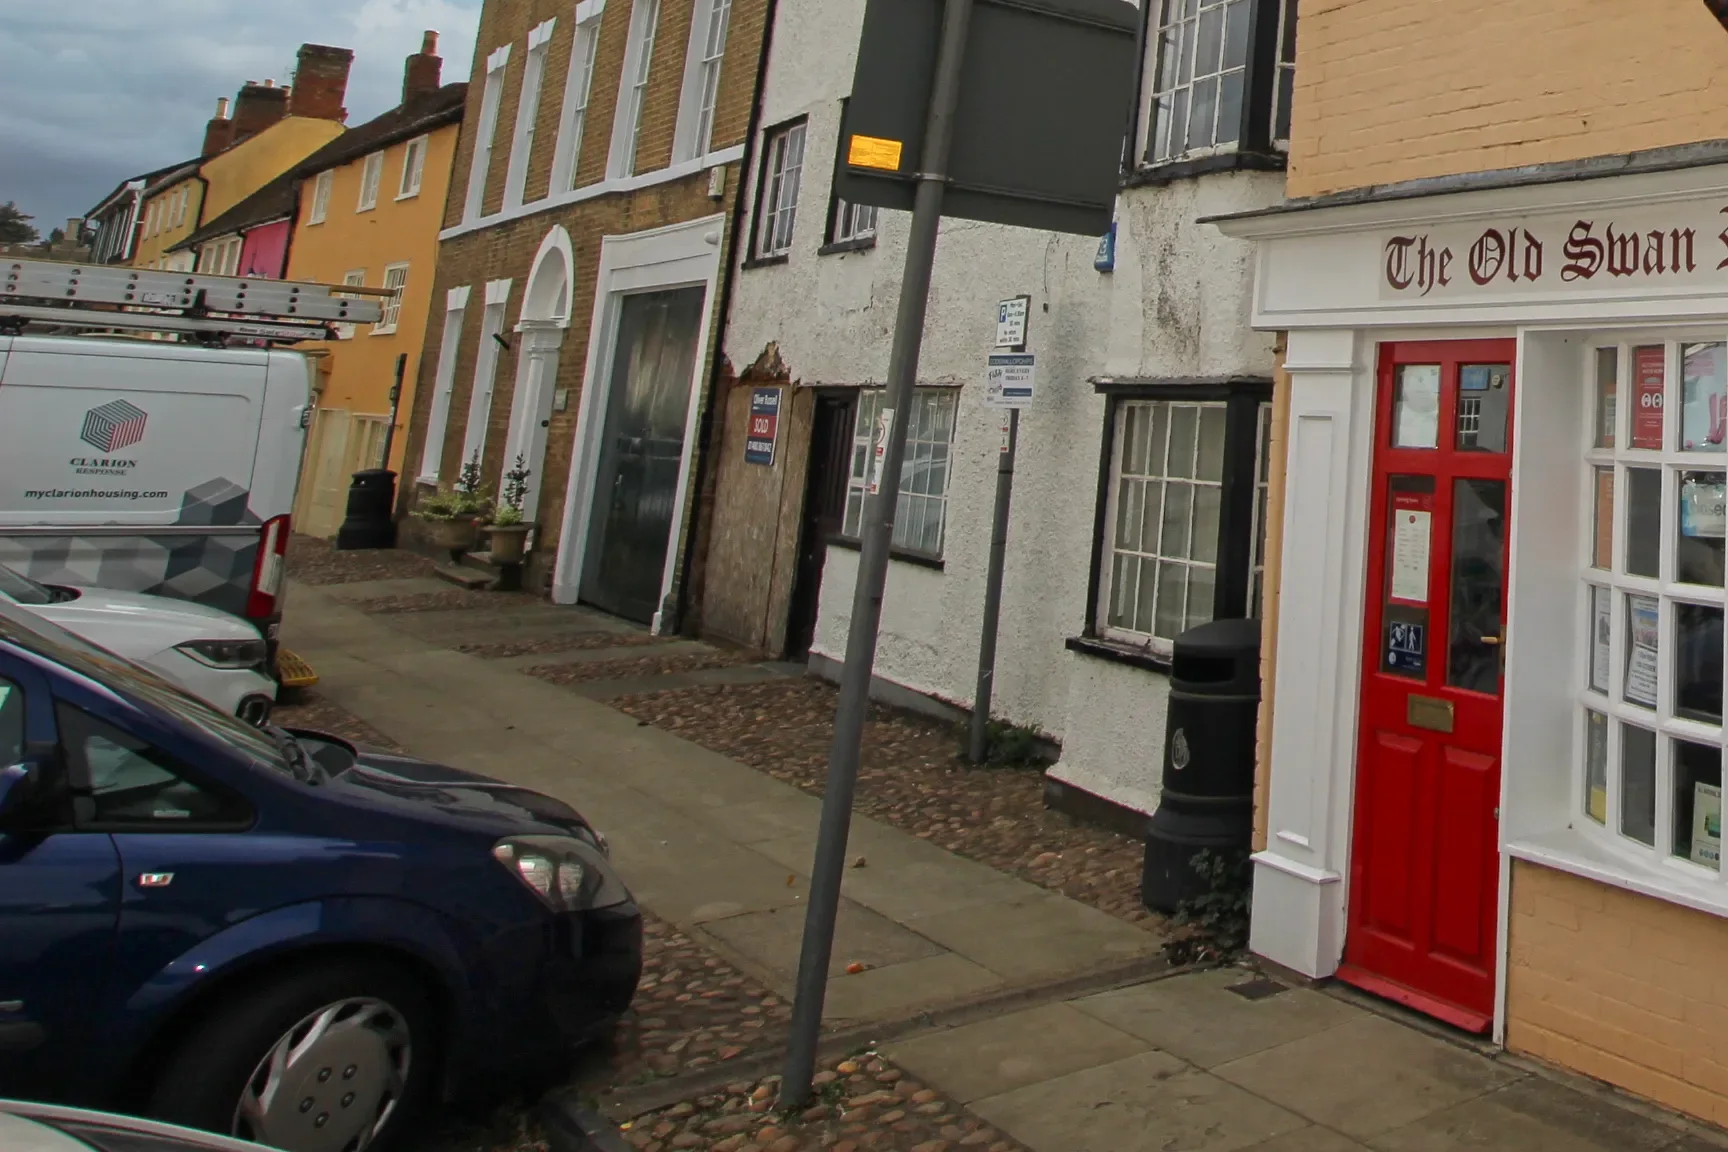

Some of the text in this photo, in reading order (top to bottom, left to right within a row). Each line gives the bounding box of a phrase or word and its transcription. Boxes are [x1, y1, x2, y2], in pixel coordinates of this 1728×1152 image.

[1384, 233, 1454, 297] The
[1468, 226, 1544, 286] Old
[1560, 219, 1697, 282] Swan
[753, 418, 769, 434] SOLD
[69, 457, 138, 468] CLARION
[75, 467, 127, 476] RESPONSE
[24, 488, 168, 500] myclarionhousing.com
